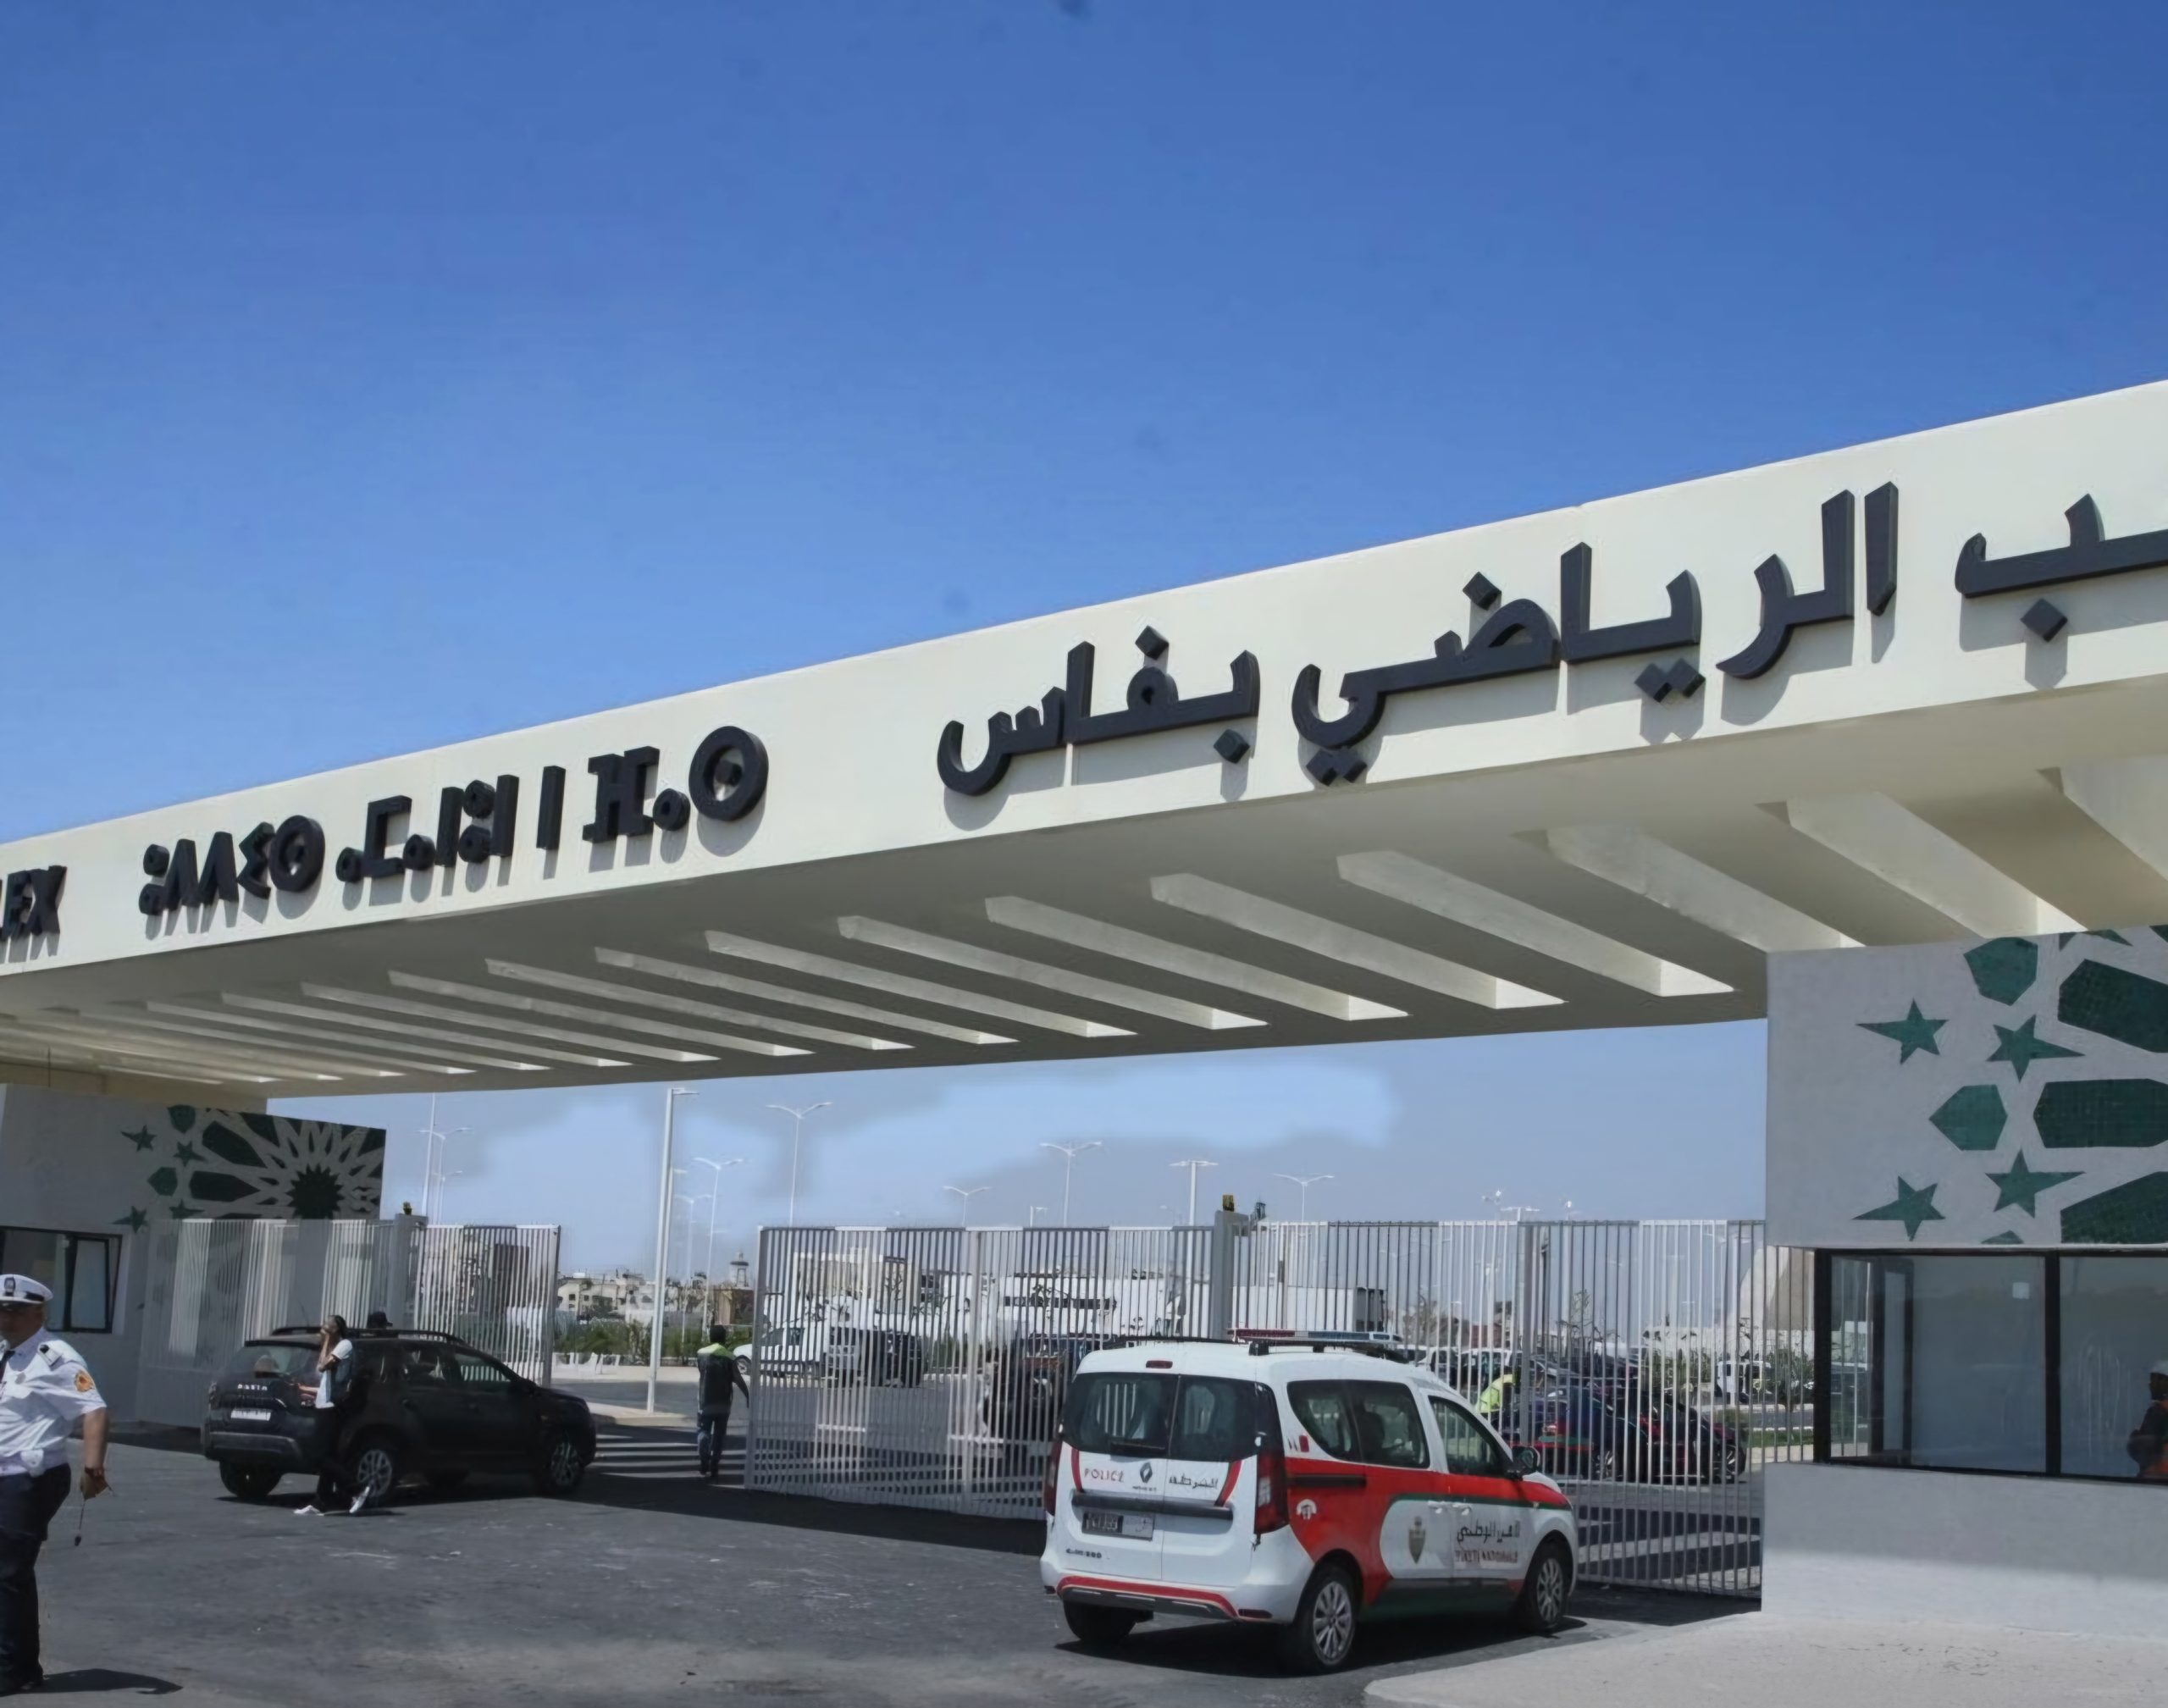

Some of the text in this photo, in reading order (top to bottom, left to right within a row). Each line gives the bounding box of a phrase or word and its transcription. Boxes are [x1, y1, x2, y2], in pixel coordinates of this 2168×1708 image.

[937, 625, 1260, 797] بفاس
[1291, 481, 1899, 786] الرياضي
[0, 865, 68, 943] EX
